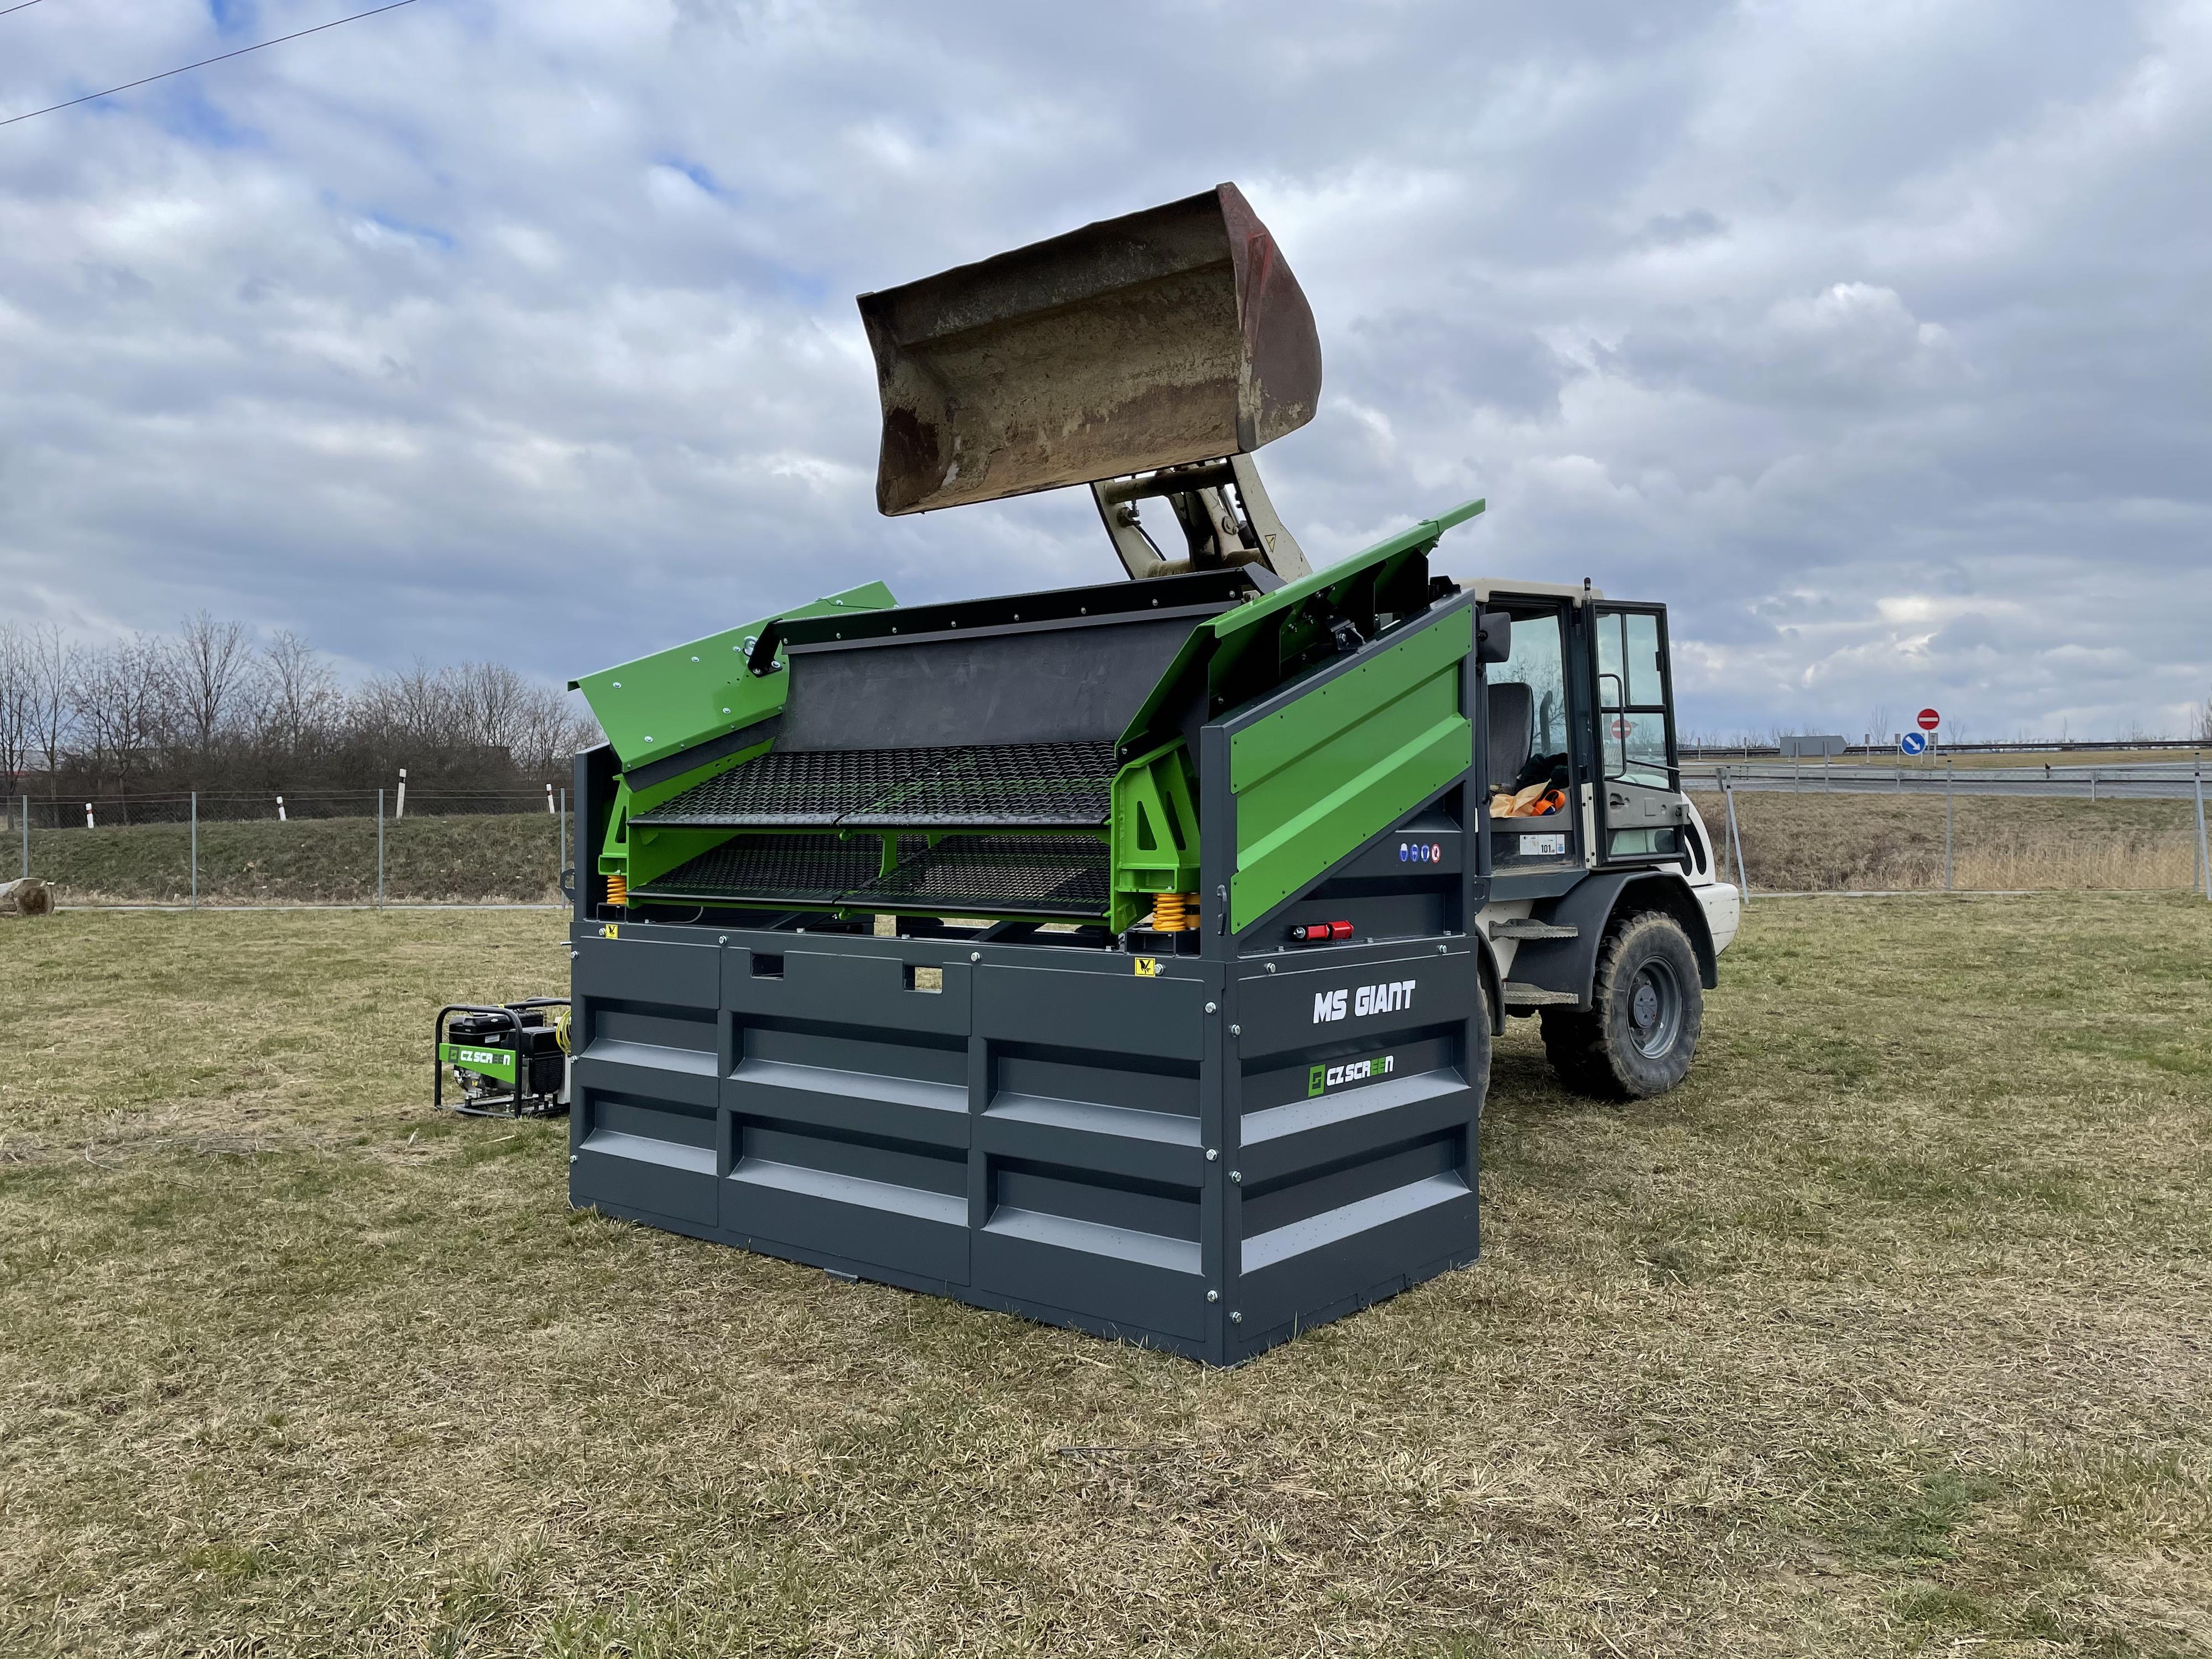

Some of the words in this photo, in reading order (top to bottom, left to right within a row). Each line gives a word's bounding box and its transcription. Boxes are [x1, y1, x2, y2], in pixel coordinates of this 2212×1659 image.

[1541, 844, 1551, 853] 101
[1313, 989, 1348, 1024] MS
[1354, 979, 1416, 1017] GIANT
[1326, 1055, 1394, 1087] CZSCREEN
